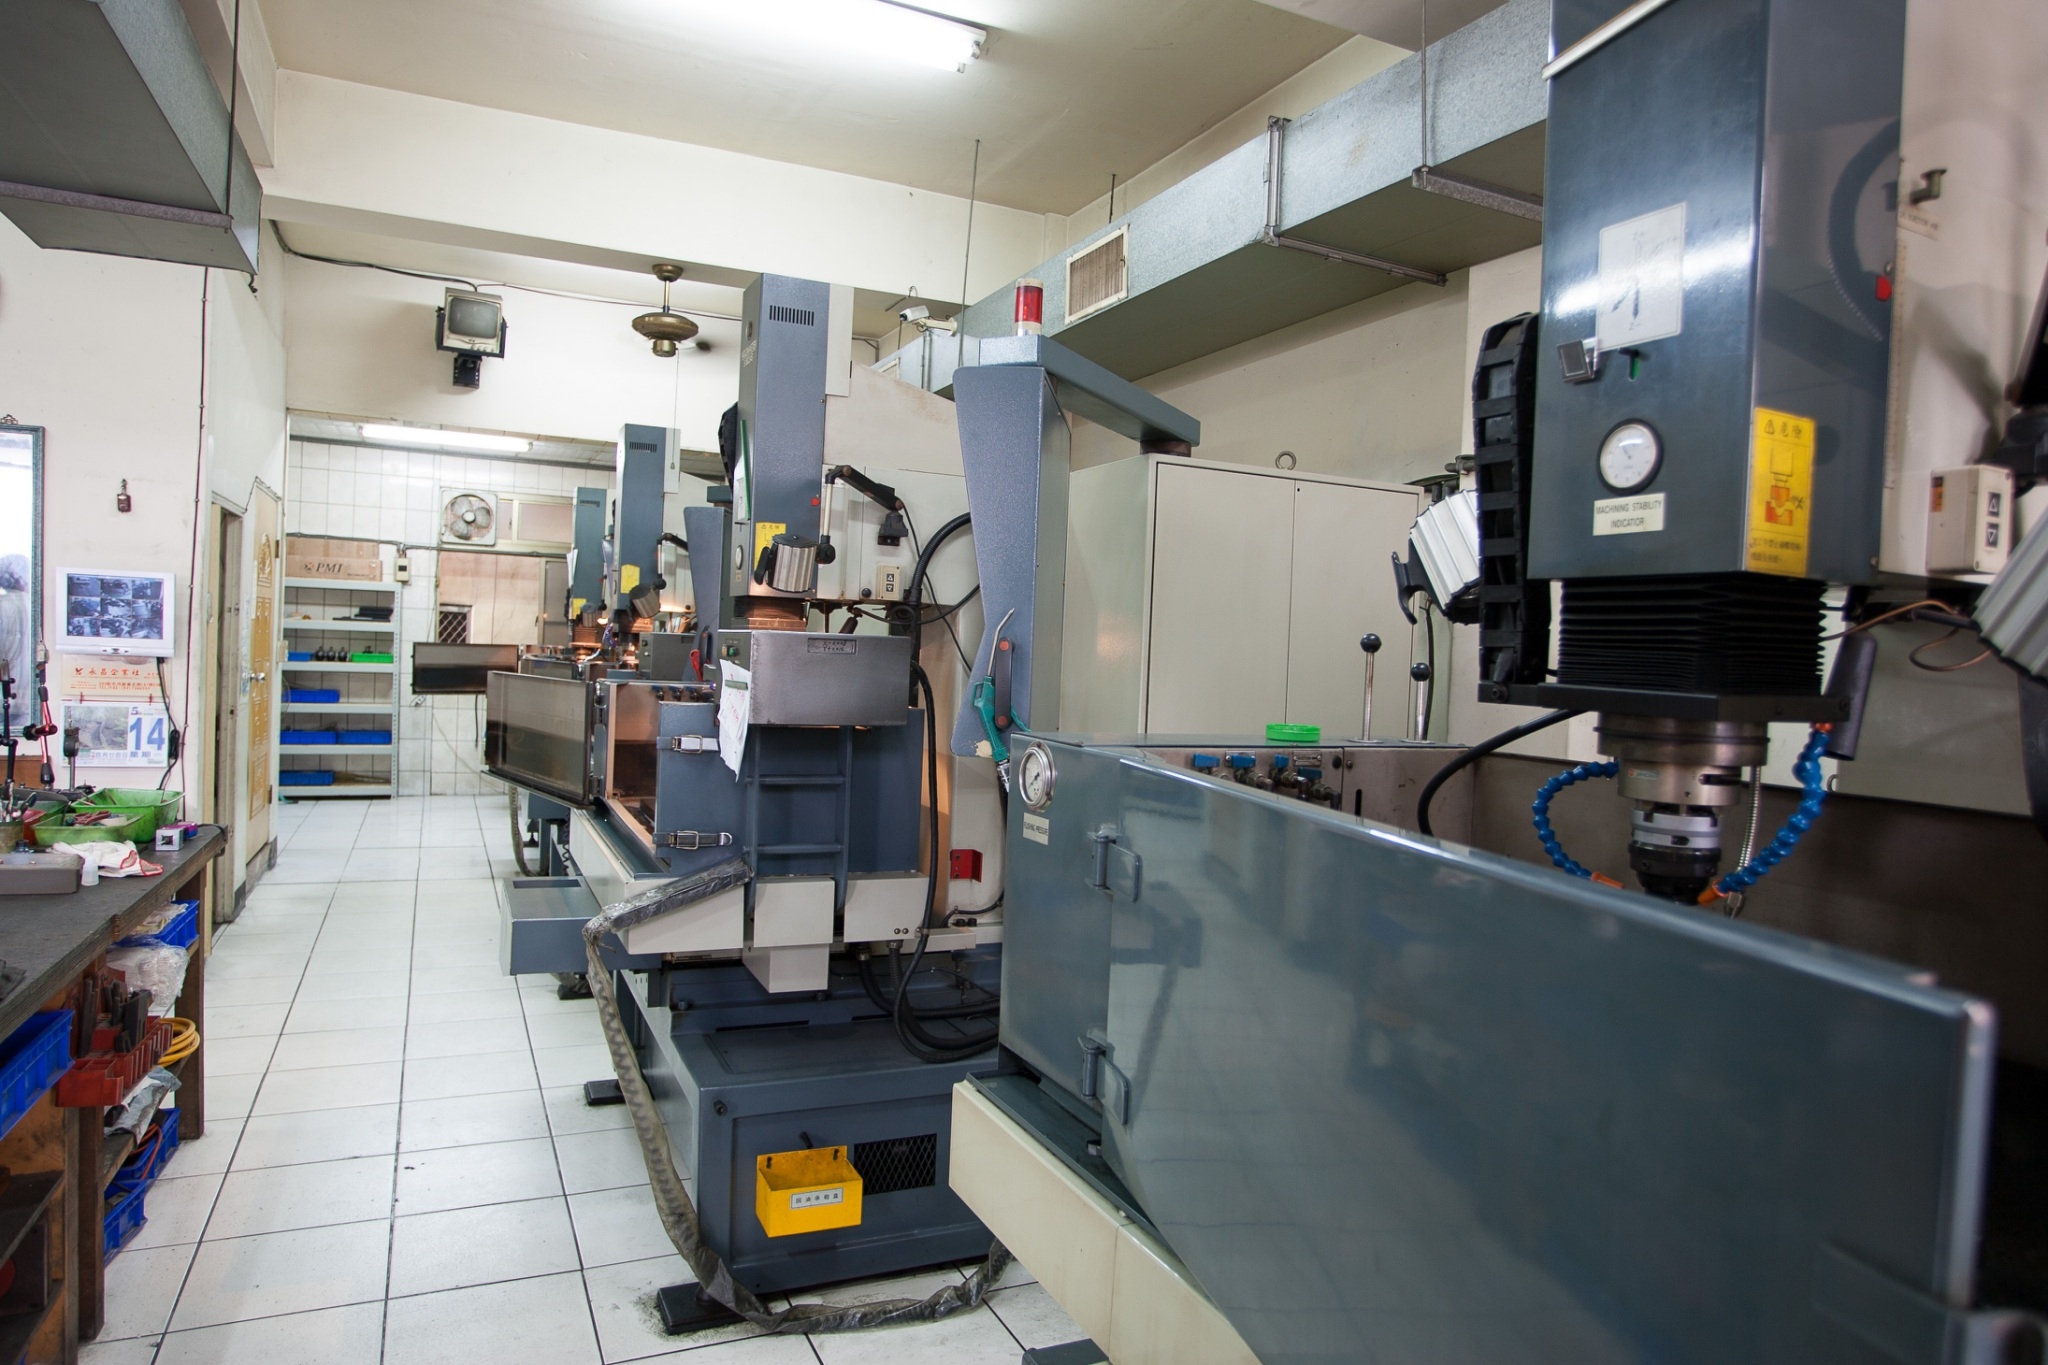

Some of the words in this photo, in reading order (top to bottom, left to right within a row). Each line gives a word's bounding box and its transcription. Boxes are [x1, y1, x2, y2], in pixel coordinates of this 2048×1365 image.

[1780, 421, 1802, 439] 危險
[1596, 503, 1629, 514] MACHINING
[1632, 500, 1662, 511] STABILITY
[316, 562, 343, 573] PMI
[89, 667, 140, 676] 永昌企業社
[130, 706, 139, 715] 5
[129, 717, 165, 750] 14
